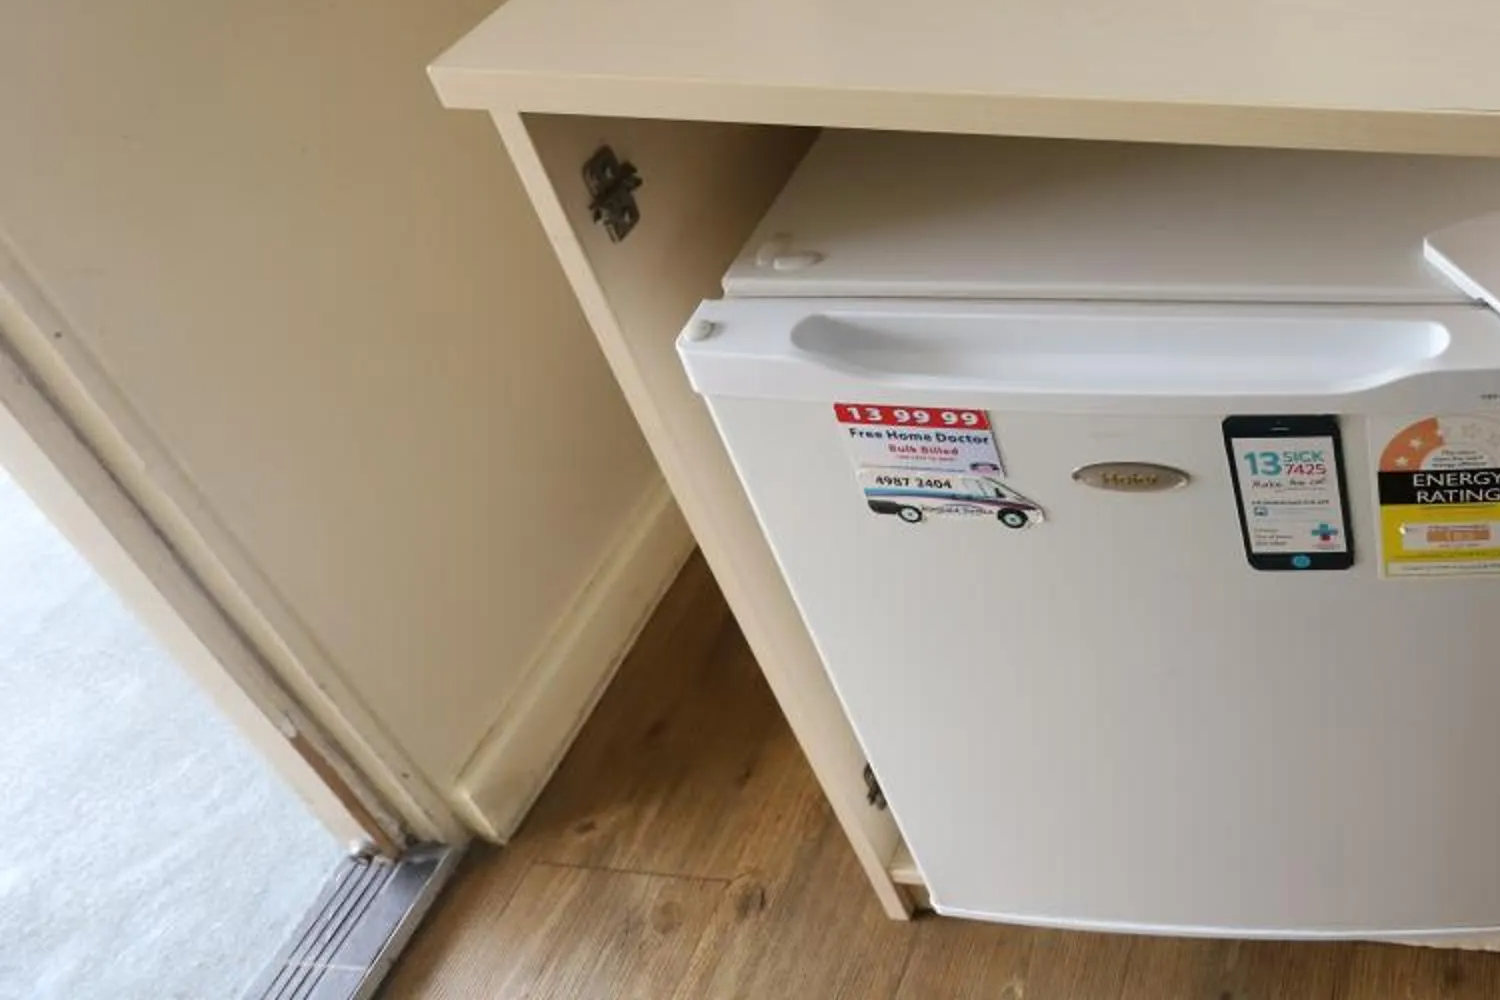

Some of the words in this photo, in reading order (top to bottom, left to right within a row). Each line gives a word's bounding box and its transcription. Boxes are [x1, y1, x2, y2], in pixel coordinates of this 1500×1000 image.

[847, 406, 883, 422] 13
[893, 409, 931, 424] 99
[940, 411, 979, 426] 99
[848, 427, 882, 439] Free
[885, 430, 932, 443] Home
[936, 431, 990, 445] Doctor
[888, 443, 917, 453] Bulk
[920, 445, 959, 456] Billed
[1243, 450, 1282, 476] 13
[1282, 449, 1324, 463] SICK
[1285, 462, 1327, 475] 7425
[875, 475, 909, 487] 4987
[916, 477, 953, 489] 2404
